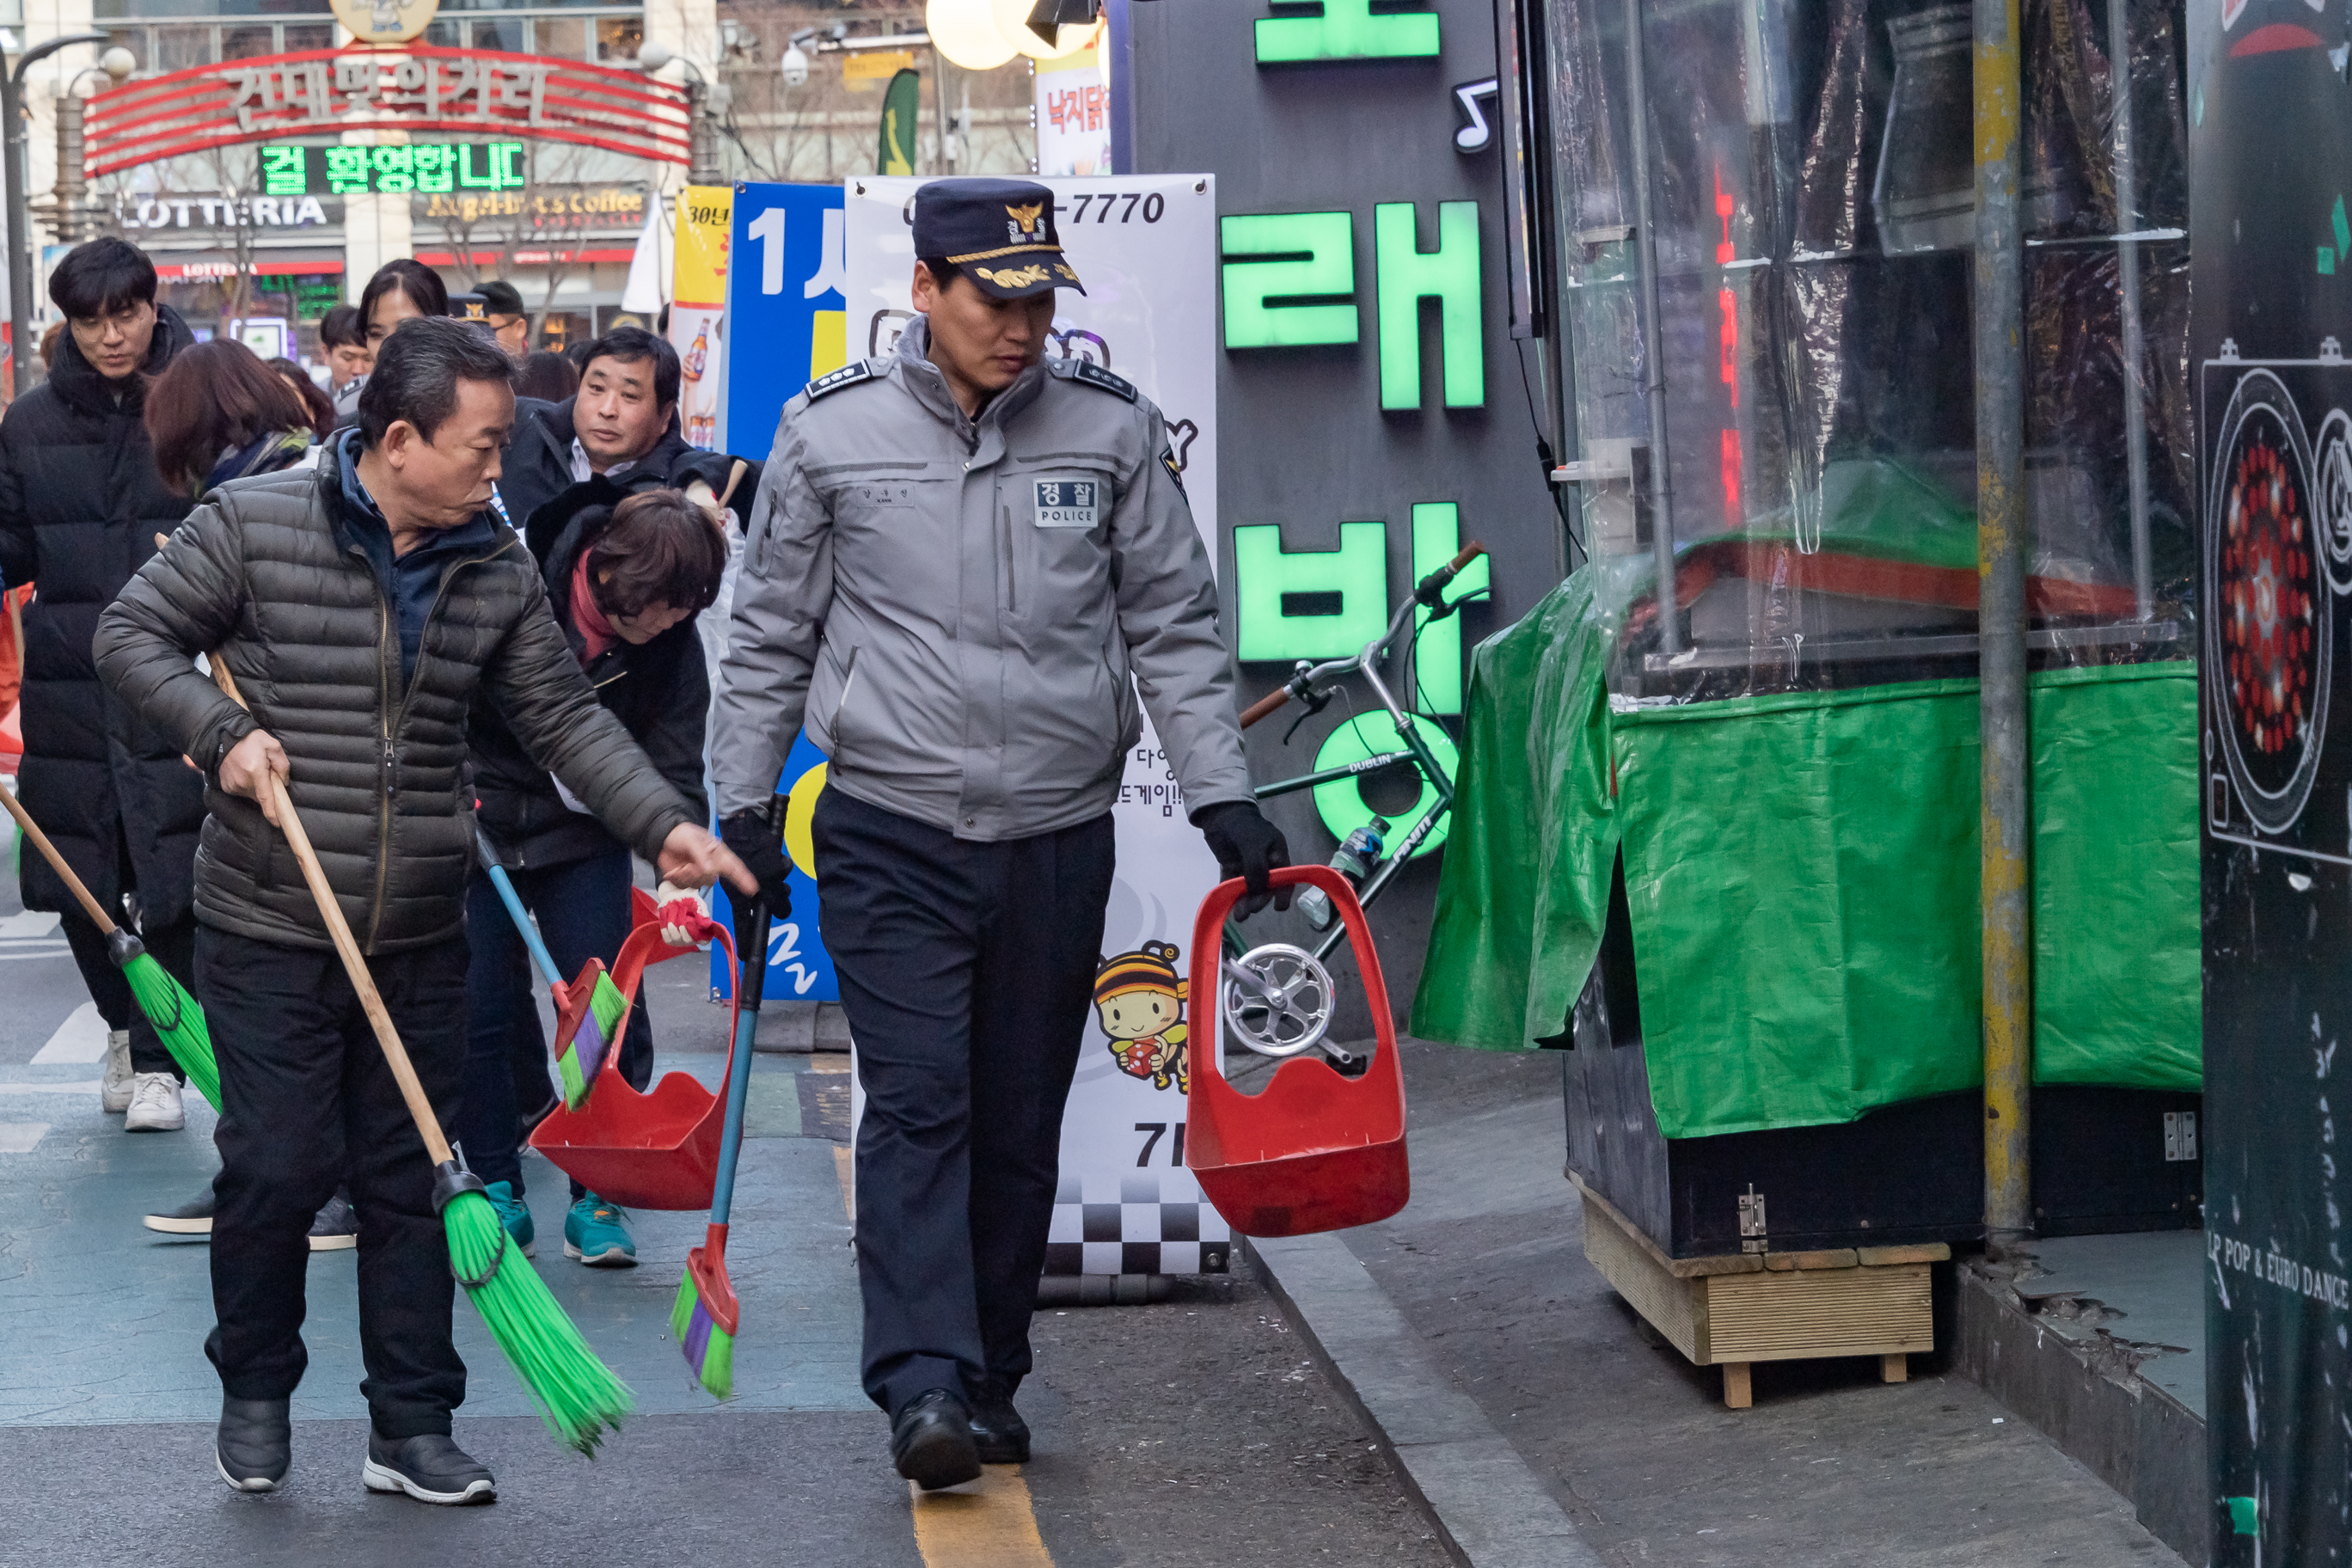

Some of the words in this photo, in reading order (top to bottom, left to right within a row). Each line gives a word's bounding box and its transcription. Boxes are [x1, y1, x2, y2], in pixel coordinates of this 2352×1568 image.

[1042, 511, 1092, 521] POLICE
[1349, 754, 1392, 773] DUBLIN
[1121, 784, 1182, 818] 드게임!!
[2225, 1236, 2251, 1272] POP
[2254, 1247, 2263, 1279] &
[2266, 1252, 2300, 1291] EURO
[2302, 1265, 2349, 1310] DANCE
